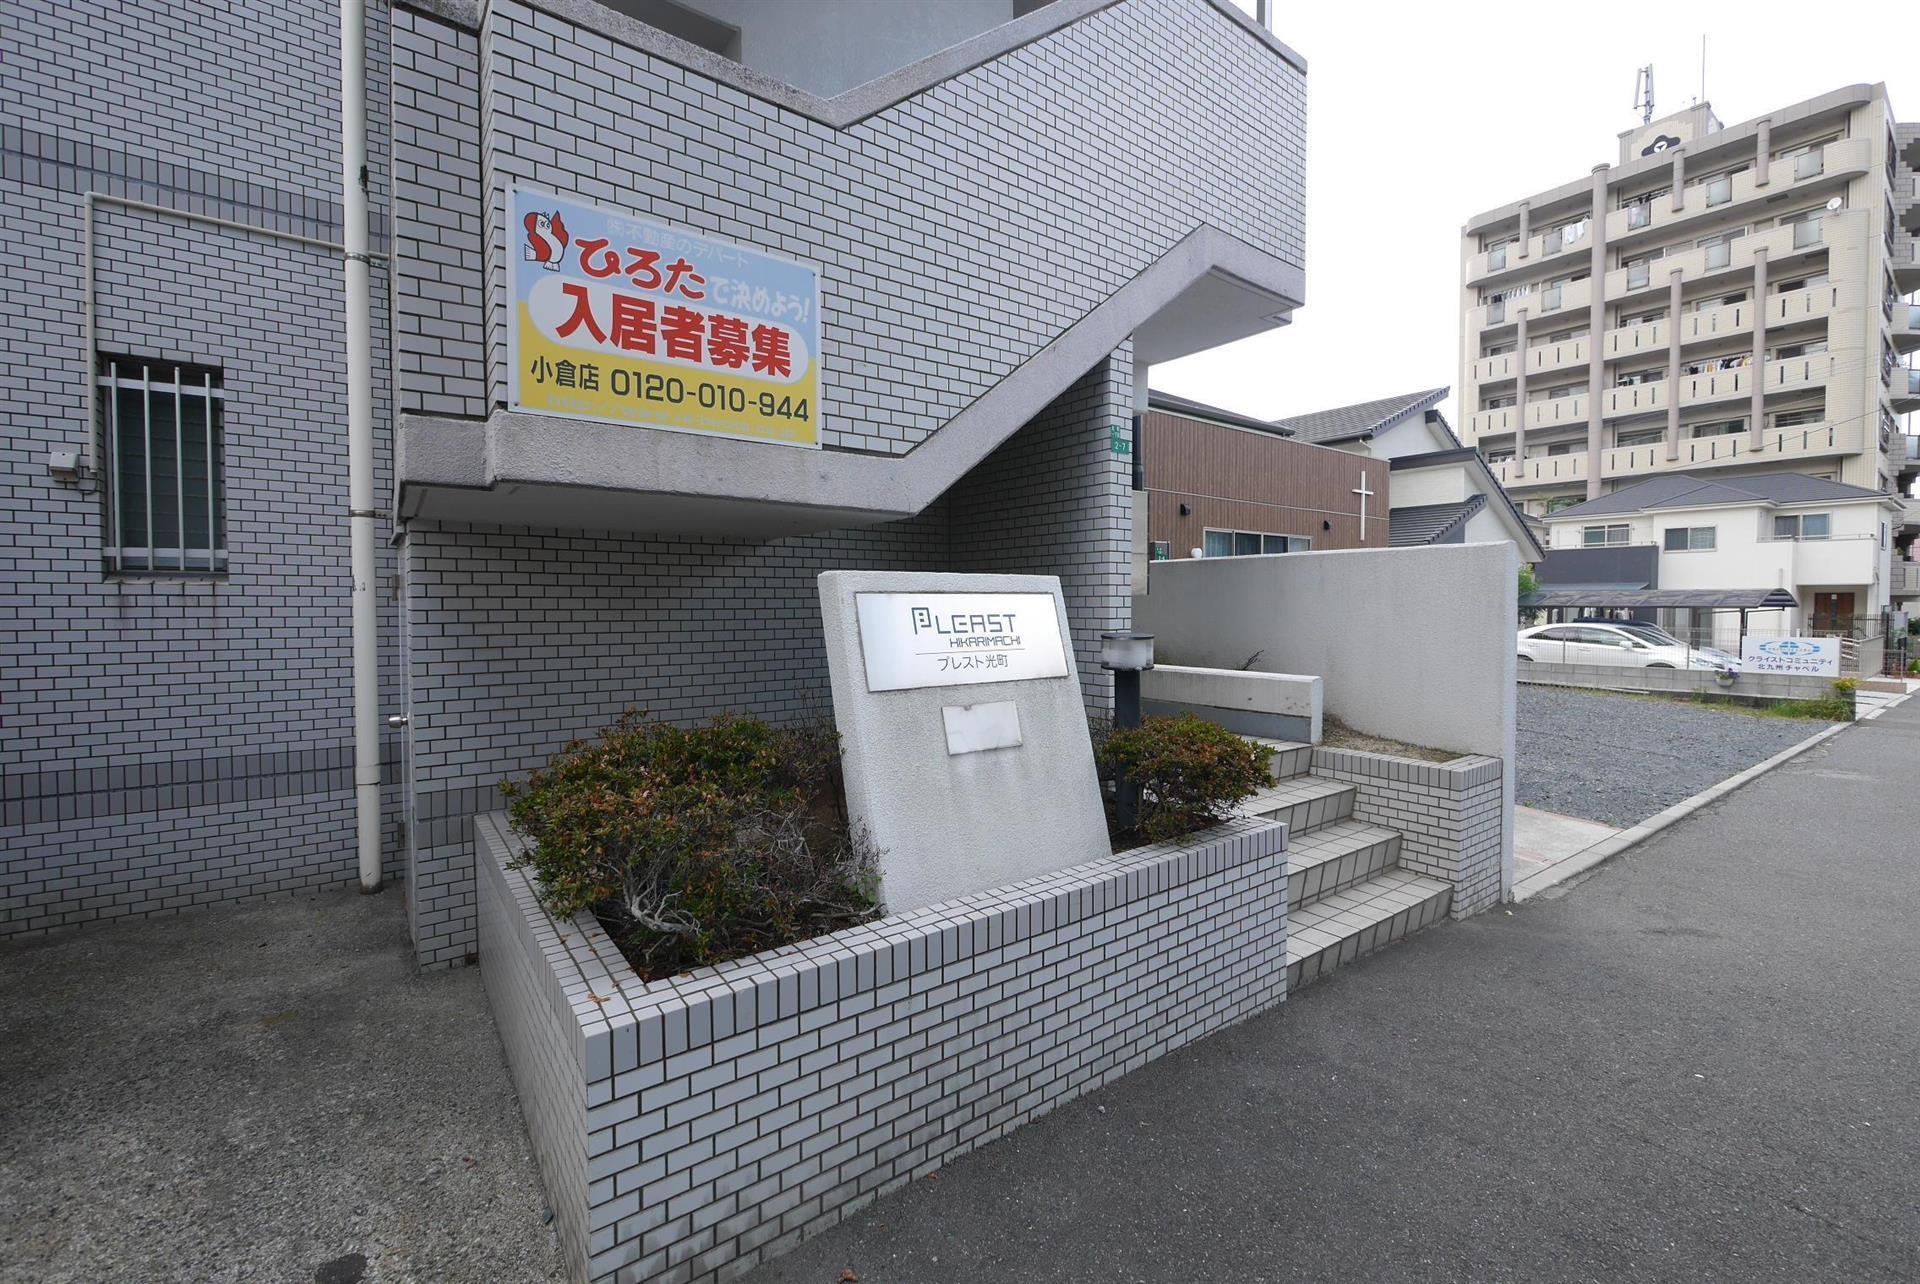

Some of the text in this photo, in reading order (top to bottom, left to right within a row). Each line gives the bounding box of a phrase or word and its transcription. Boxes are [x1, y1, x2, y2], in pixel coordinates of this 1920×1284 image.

[555, 282, 792, 378] 入居者募集
[531, 355, 599, 391] 小倉店
[611, 369, 809, 422] 0120-010-944
[911, 607, 1016, 635] PLEAST
[949, 636, 1021, 648] HIKARIMACHI
[937, 654, 1008, 671] プレスト光町
